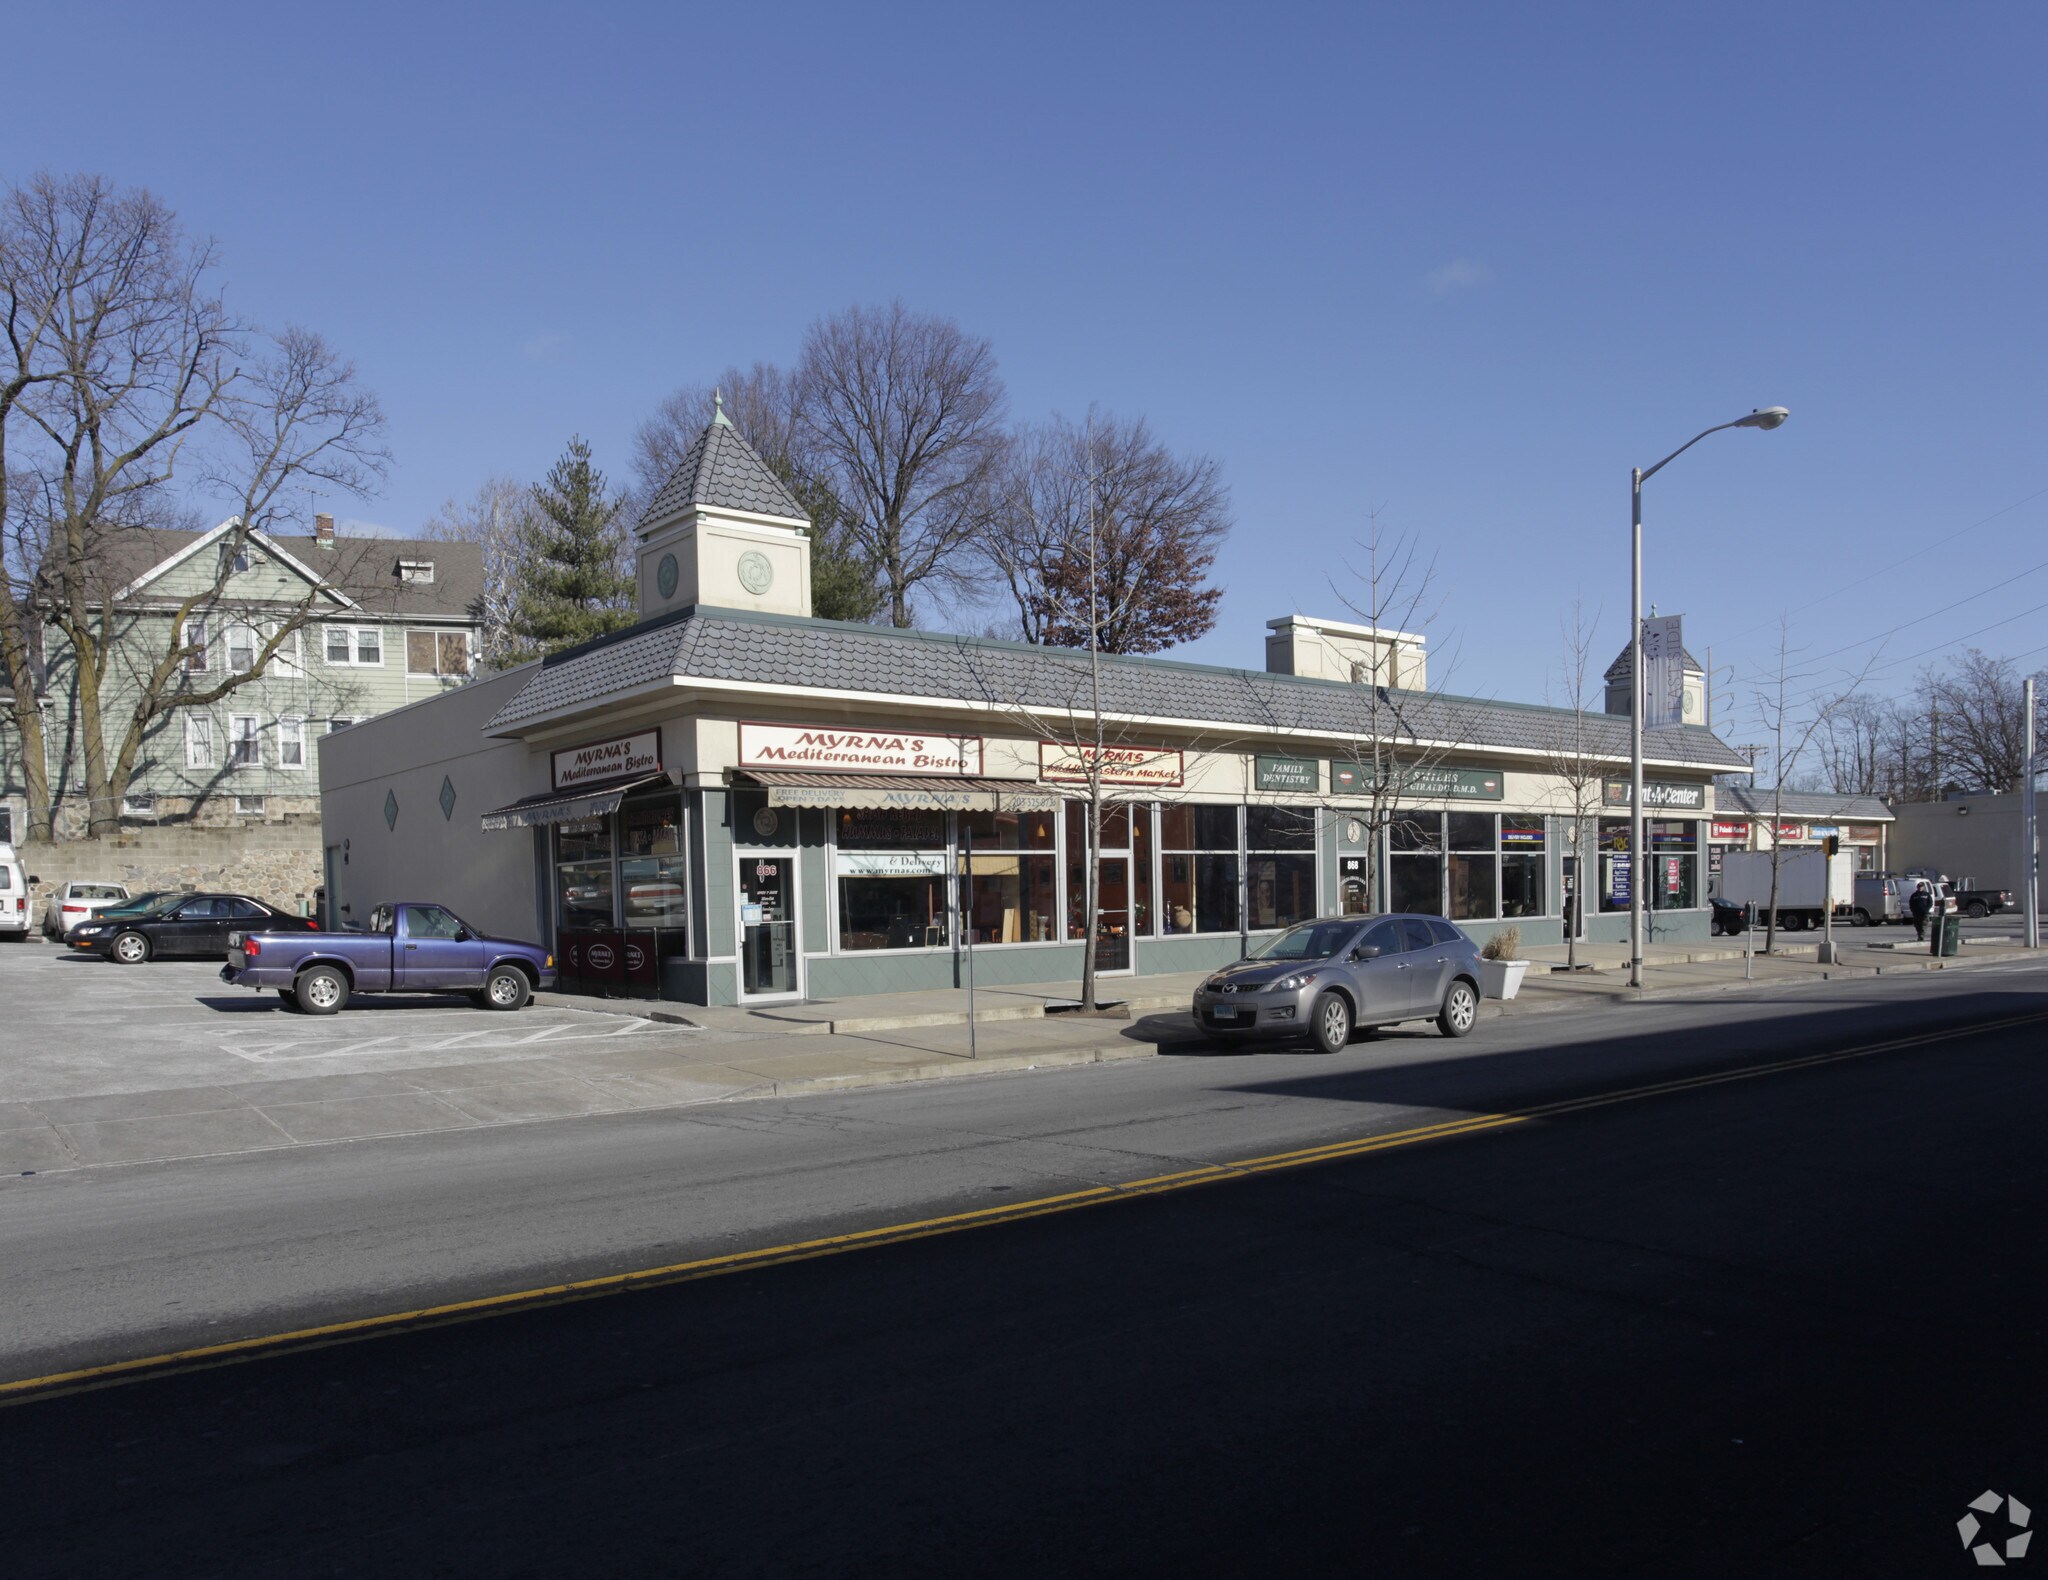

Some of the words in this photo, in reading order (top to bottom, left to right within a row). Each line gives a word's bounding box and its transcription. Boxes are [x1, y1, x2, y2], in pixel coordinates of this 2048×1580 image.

[795, 732, 924, 752] MYRNA'S
[575, 742, 631, 766] MYRNA'S
[756, 746, 905, 765] Mediterranean
[913, 755, 968, 768] Bistro
[1083, 749, 1144, 763] MRNA'S
[561, 763, 623, 783] Mediterranean
[626, 754, 654, 771] Bistro
[1137, 769, 1176, 778] Market
[1272, 763, 1304, 774] FAMILY
[1263, 773, 1311, 785] DENTISTRY
[1413, 770, 1458, 782] SMILES
[776, 788, 799, 796] FREE
[801, 789, 846, 797] DELIVERY
[882, 792, 970, 805] MYRNA'S
[890, 856, 898, 866] &
[901, 857, 942, 868] Delivery
[1347, 860, 1359, 870] 868
[756, 865, 777, 876] 866
[850, 867, 931, 876] www.myrnas.com
